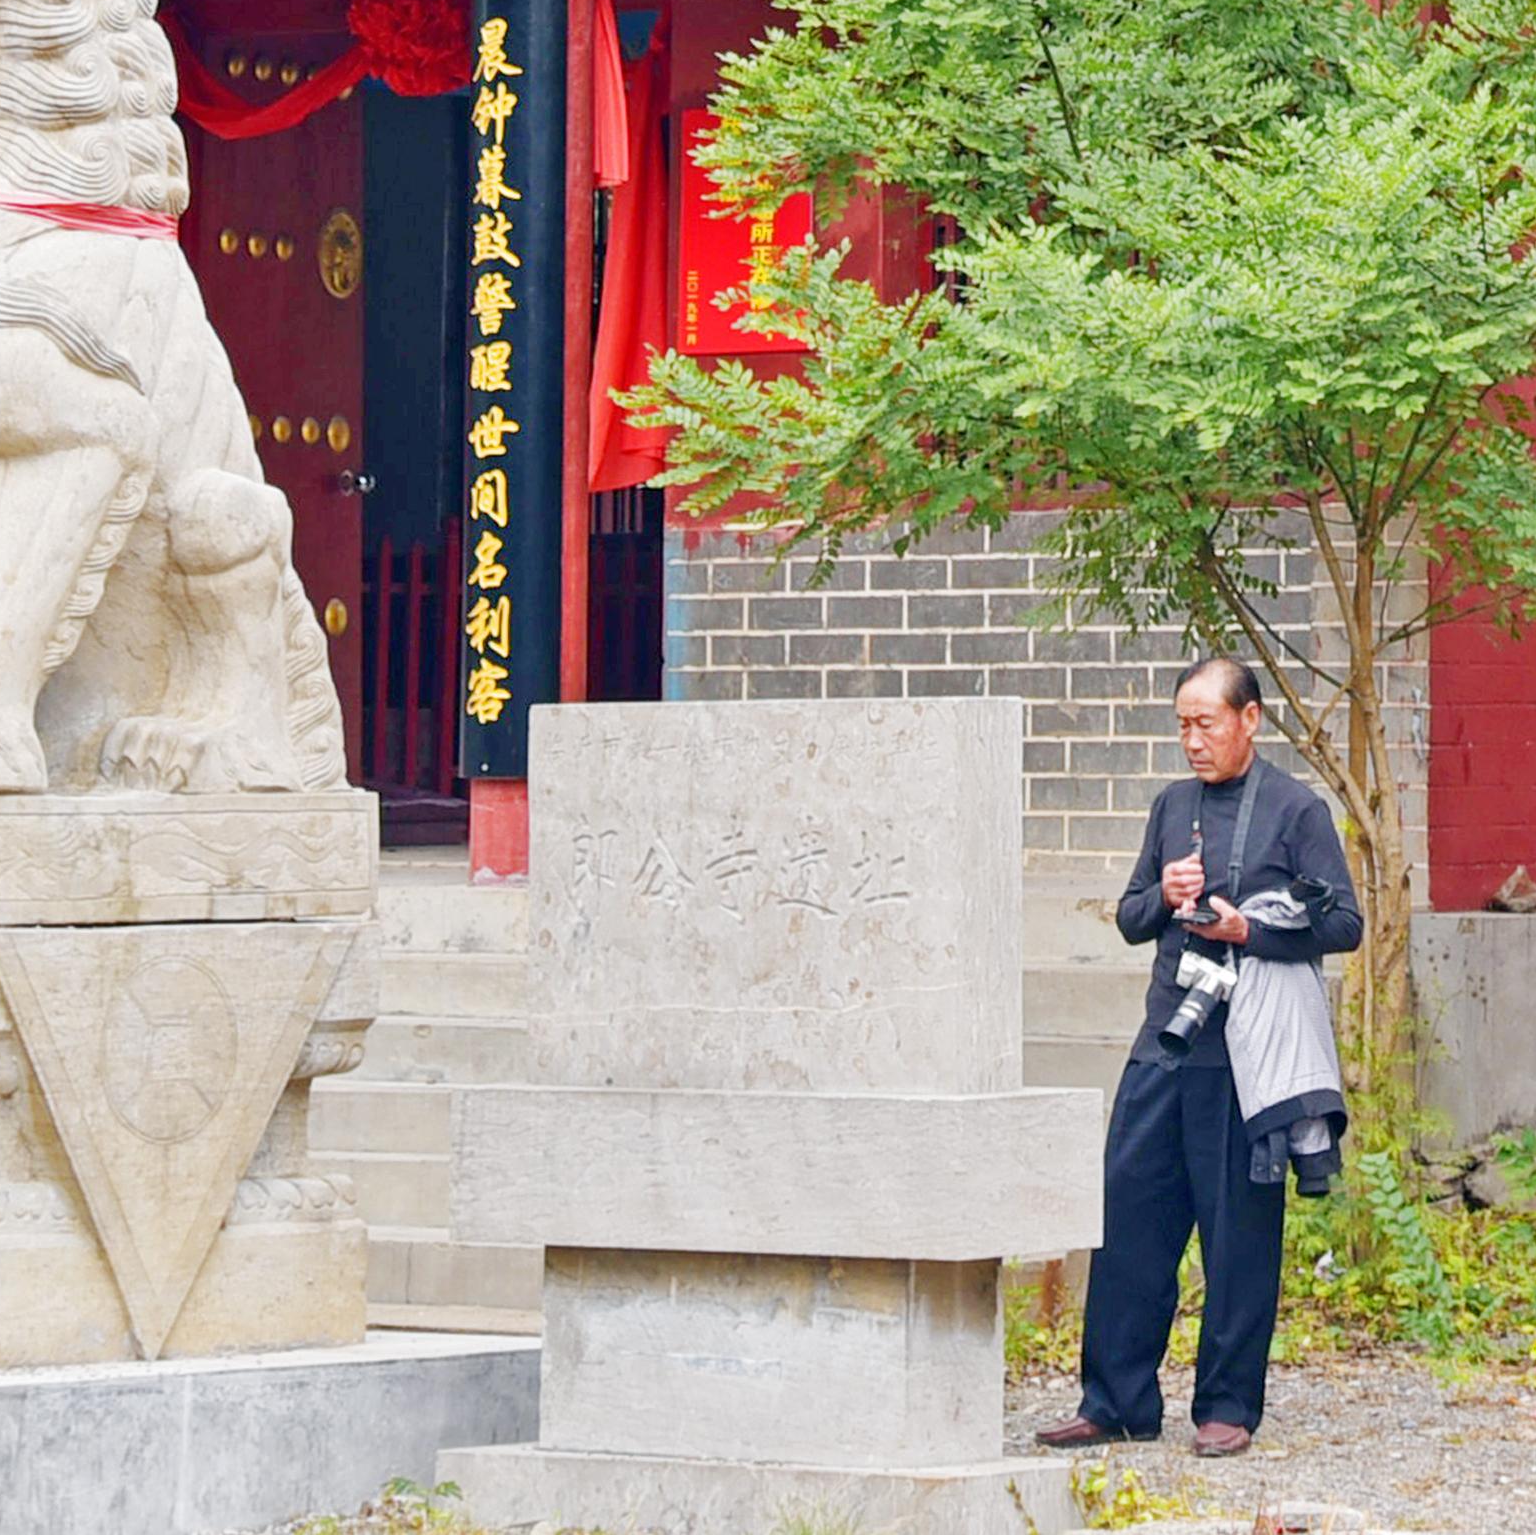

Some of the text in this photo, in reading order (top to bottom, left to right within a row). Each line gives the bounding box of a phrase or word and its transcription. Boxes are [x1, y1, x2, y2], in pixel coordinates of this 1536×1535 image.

[465, 16, 524, 725] 晨钟暮鼓警醒世间名利客
